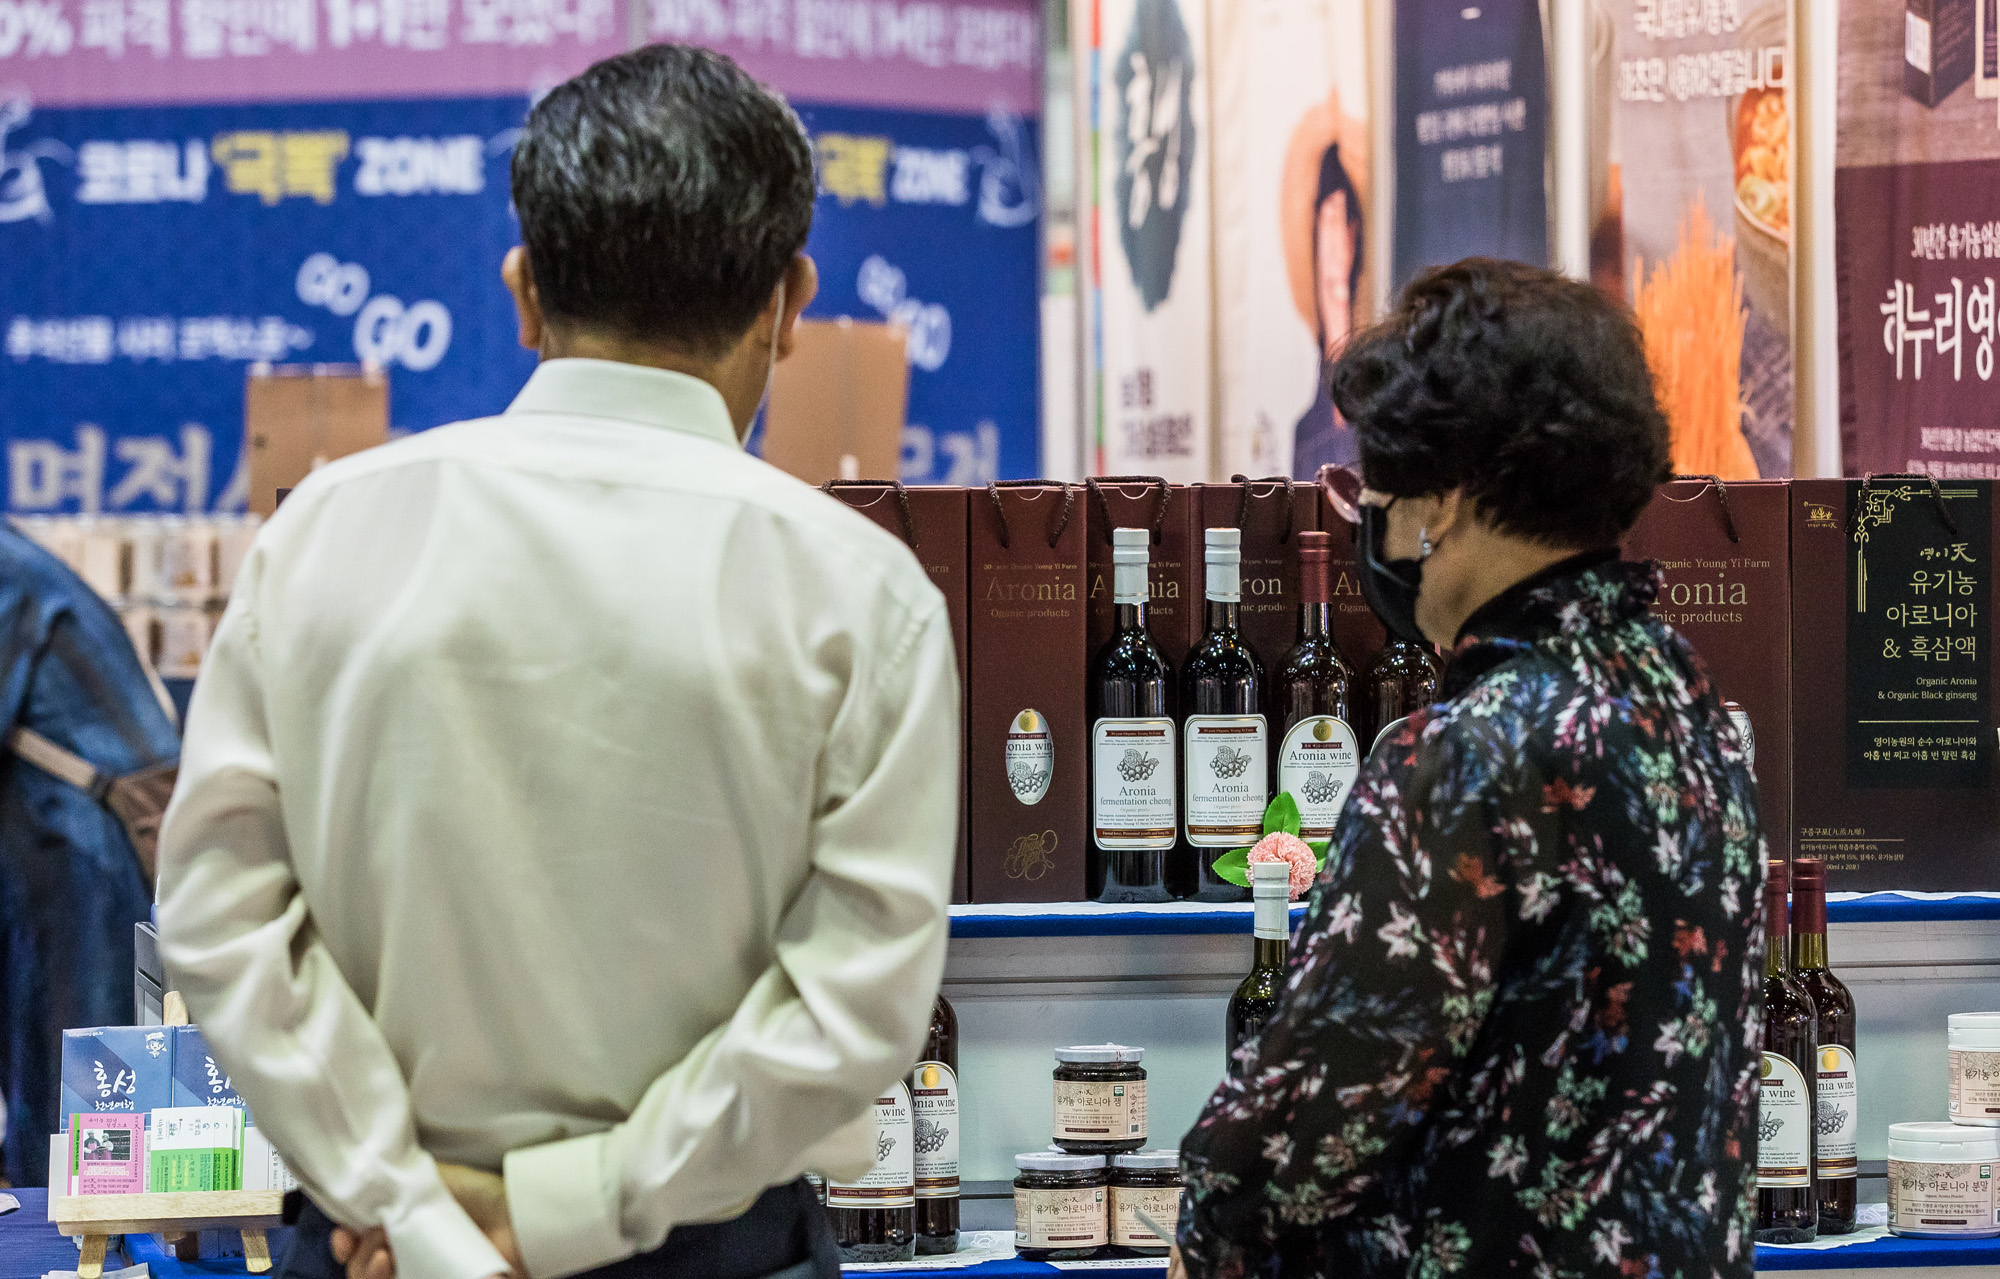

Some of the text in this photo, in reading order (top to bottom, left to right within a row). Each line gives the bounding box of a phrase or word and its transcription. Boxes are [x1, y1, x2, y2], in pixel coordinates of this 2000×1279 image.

[296, 252, 371, 317] GO
[353, 295, 453, 372] GO
[1880, 276, 2000, 382] 하누리영
[1696, 558, 1727, 570] Young
[1730, 558, 1741, 568] Yi
[1744, 558, 1770, 568] Farm
[986, 576, 1076, 601] Aronia
[1089, 574, 1179, 599] Ania
[1652, 572, 1748, 605] ronia
[1908, 570, 1978, 596] 유기농
[1027, 607, 1070, 618] products
[1681, 610, 1743, 625] products
[1886, 603, 1978, 628] 아로니아
[1882, 636, 1977, 662] & 흑삼액
[1916, 676, 1978, 687] Organic Aronia
[1877, 691, 1978, 702] & Organic Black ginseng
[1035, 739, 1052, 751] win
[1873, 736, 1977, 748] 영이농원의 순수 아로니아와
[1290, 750, 1352, 761] Aronia wine
[1863, 750, 1977, 761] 아홉 번 찌고 아홉 번 말린 흑삼
[1119, 785, 1156, 797] Aronia
[1212, 782, 1249, 793] Aronia
[1100, 796, 1172, 806] fermentation cheong
[1192, 792, 1264, 803] fermentation cheong
[94, 1060, 136, 1098] 홍성
[1965, 1068, 1991, 1081] 유기농
[1817, 1078, 1854, 1091] nia wine
[1769, 1087, 1796, 1098] wine
[95, 1099, 135, 1111] 천년여행
[937, 1096, 956, 1108] wine
[1077, 1097, 1111, 1107] 아로니아
[1113, 1097, 1122, 1107] 잼
[882, 1105, 906, 1117] wine
[1901, 1179, 1988, 1192] 유기농 아로니아 분말
[1036, 1204, 1060, 1215] 유기농
[1063, 1203, 1094, 1214] 아로니아
[1144, 1203, 1177, 1214] 아로니아
